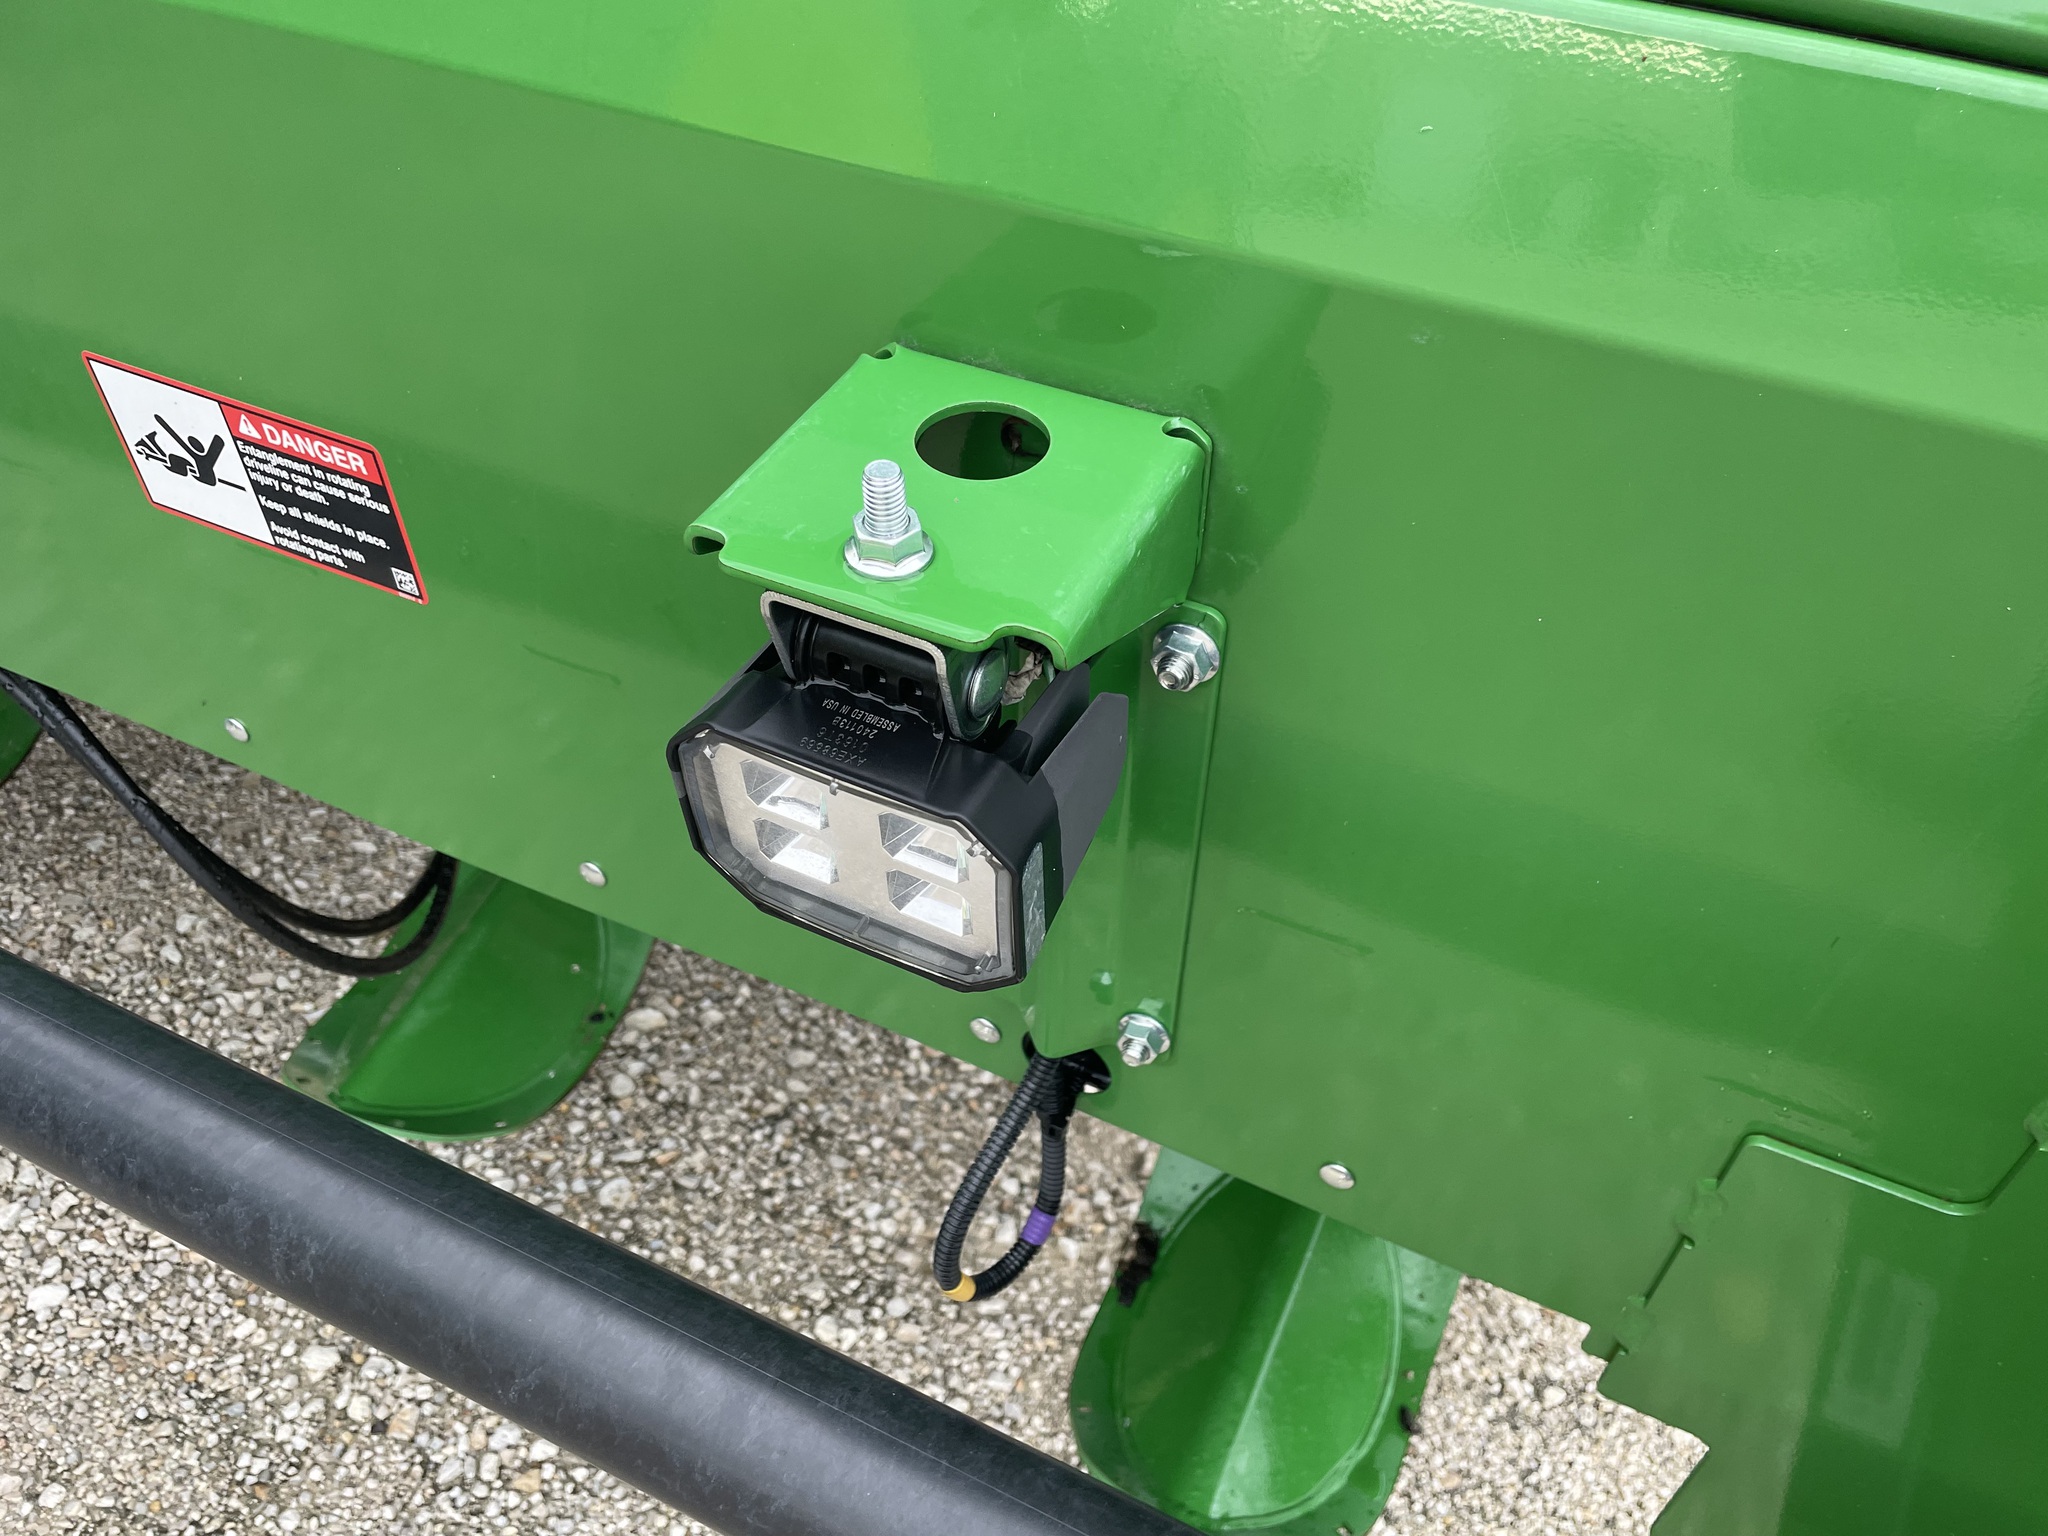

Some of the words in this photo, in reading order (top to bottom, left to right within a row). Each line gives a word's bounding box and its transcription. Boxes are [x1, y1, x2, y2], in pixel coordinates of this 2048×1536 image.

[236, 440, 312, 476] Entanglement
[312, 465, 325, 480] in
[326, 472, 371, 498] rotating
[261, 423, 368, 475] DANGER
[243, 456, 290, 480] driveline
[290, 473, 312, 488] can
[312, 481, 347, 500] cause
[347, 492, 391, 514] serious
[247, 468, 280, 491] injury
[281, 482, 293, 493] or
[295, 486, 330, 506] death.
[258, 494, 287, 516] Keep
[287, 506, 302, 519] all
[302, 512, 343, 533] shields
[342, 523, 355, 538] in
[356, 530, 391, 550] place.
[270, 521, 300, 541] Avoid
[300, 534, 341, 556] contact
[341, 548, 366, 564] with
[274, 535, 316, 559] rotating
[315, 550, 348, 569] parts.
[822, 697, 839, 712] USA
[840, 705, 852, 716] IN
[851, 708, 901, 732] ASSEMBLED
